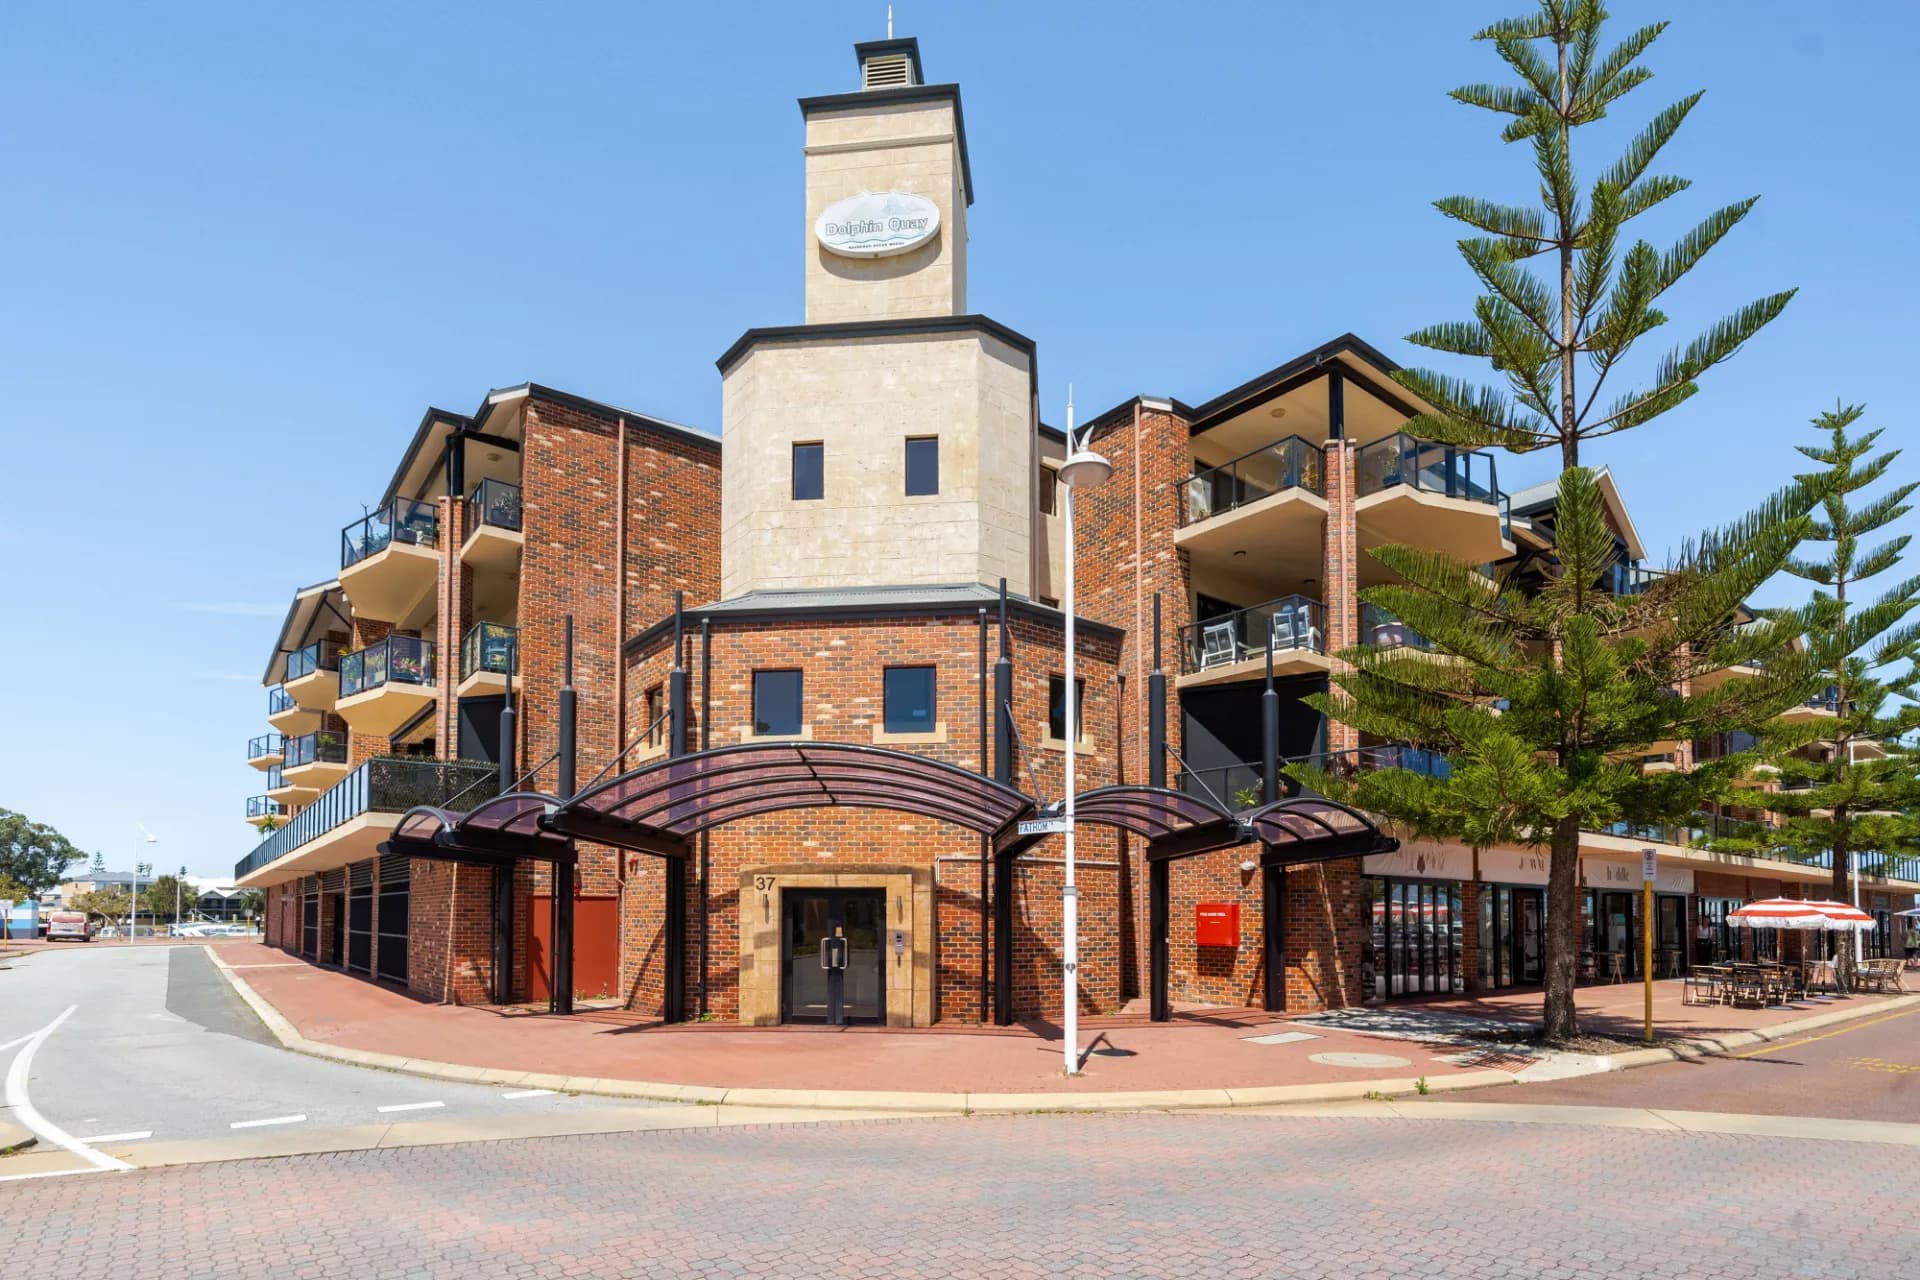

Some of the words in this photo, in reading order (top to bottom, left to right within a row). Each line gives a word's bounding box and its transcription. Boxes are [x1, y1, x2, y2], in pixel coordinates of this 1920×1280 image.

[825, 219, 884, 237] Dolphin
[888, 217, 929, 232] Quay
[1019, 820, 1048, 833] FATHOM
[755, 876, 776, 891] 37
